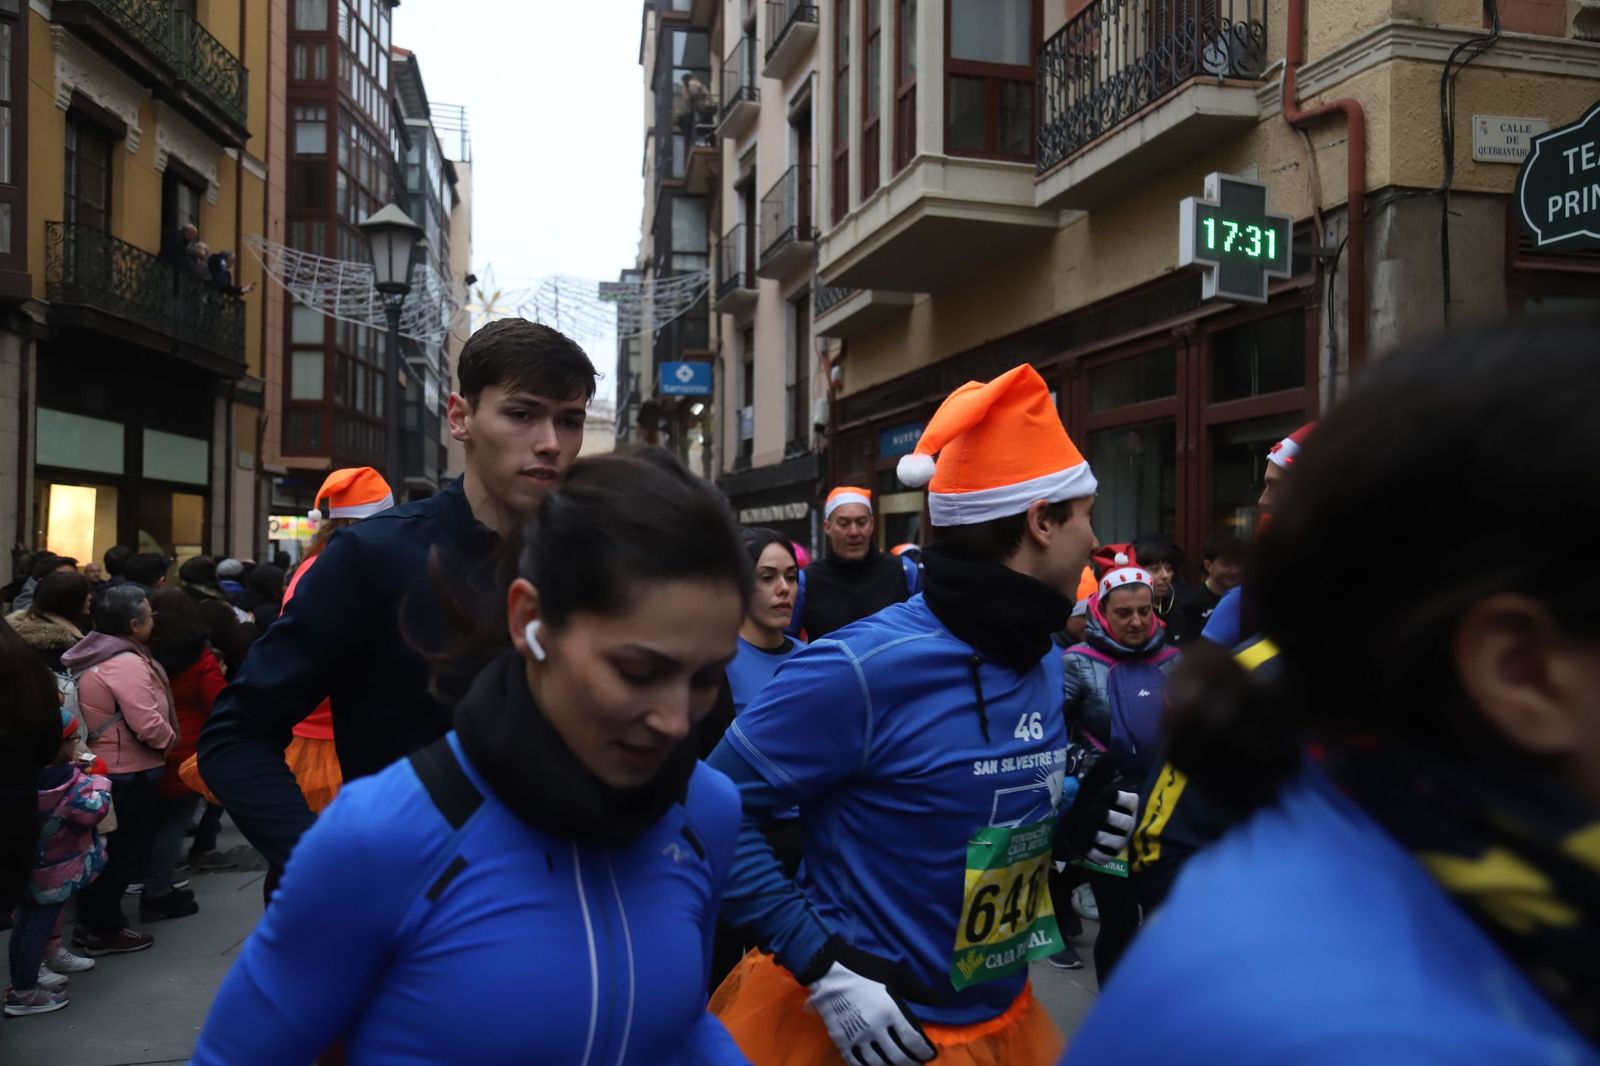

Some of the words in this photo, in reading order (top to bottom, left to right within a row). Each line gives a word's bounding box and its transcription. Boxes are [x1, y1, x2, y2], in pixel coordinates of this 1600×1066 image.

[1500, 123, 1532, 134] CALLE
[1506, 135, 1520, 145] DE
[1563, 141, 1600, 175] TE
[1203, 217, 1275, 260] 17:31
[1014, 711, 1044, 742] 46
[973, 760, 998, 775] SAN
[1001, 751, 1052, 772] SILVESTRE
[1104, 861, 1126, 873] URAL
[985, 949, 1015, 968] CAJA
